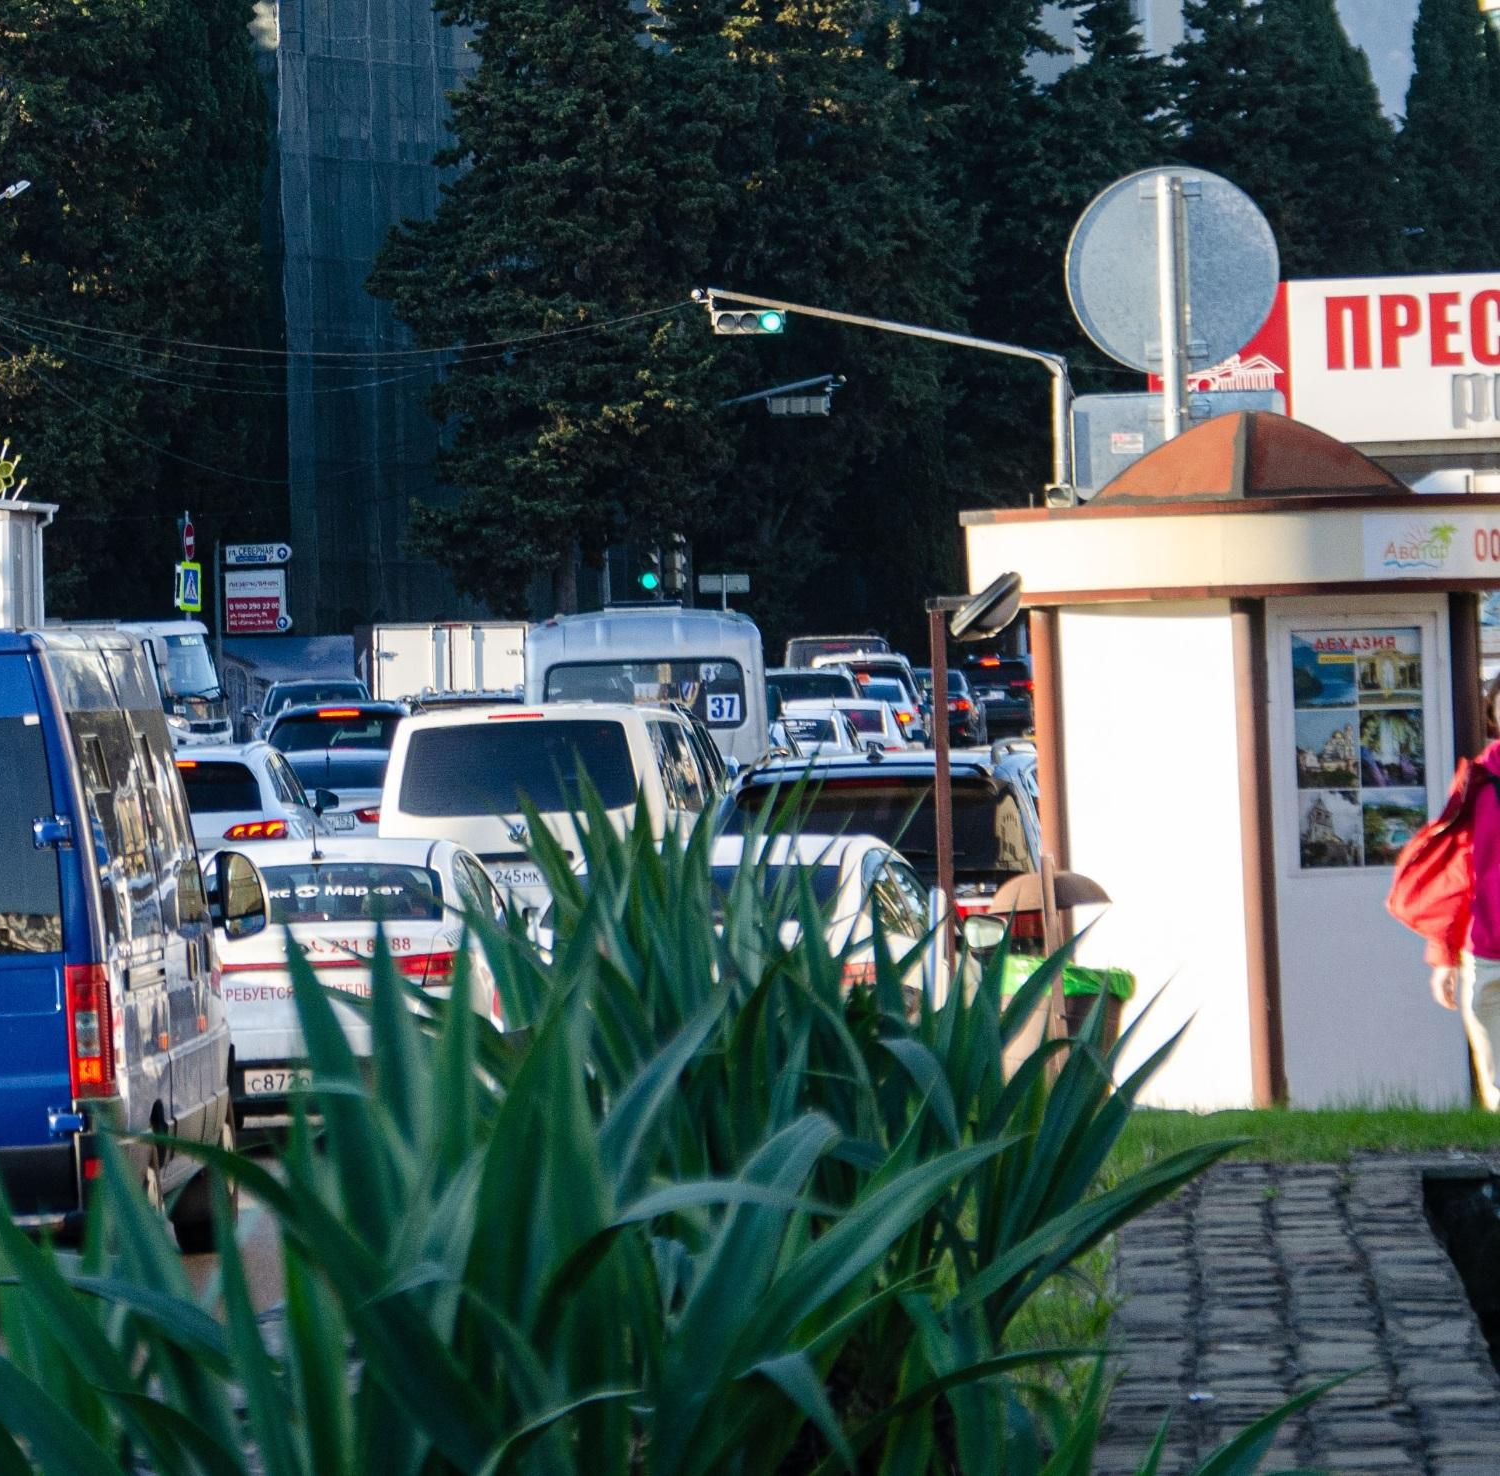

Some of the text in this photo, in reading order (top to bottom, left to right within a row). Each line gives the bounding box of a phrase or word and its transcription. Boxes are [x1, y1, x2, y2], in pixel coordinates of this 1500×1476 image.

[1452, 373, 1500, 429] р
[238, 546, 274, 556] СЕВЕРНАЯ
[1314, 636, 1396, 651] АБХАЗИЯ
[711, 697, 735, 719] 37
[392, 938, 411, 951] 88
[222, 986, 295, 1002] РЕБУЕТСЯ
